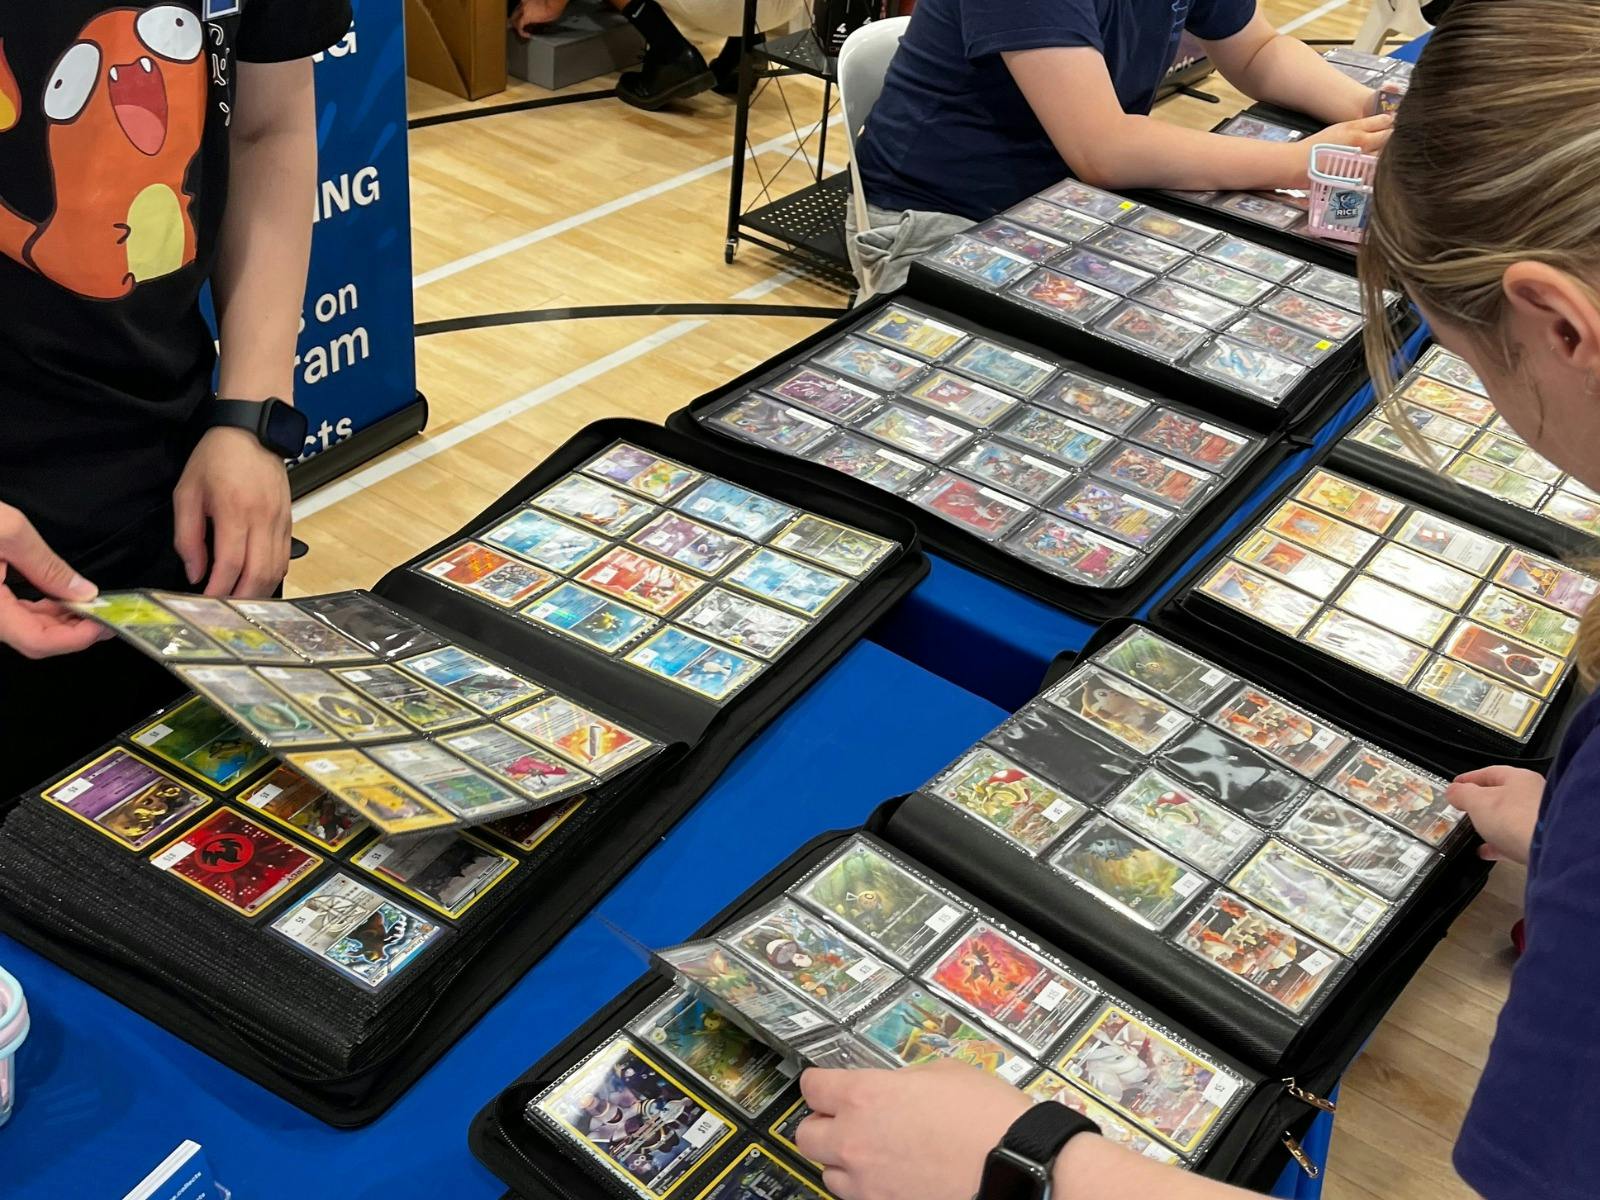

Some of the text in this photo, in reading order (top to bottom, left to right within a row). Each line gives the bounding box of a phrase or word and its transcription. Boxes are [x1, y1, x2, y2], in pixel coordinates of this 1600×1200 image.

[1336, 208, 1359, 217] RICE
[314, 283, 358, 323] on
[286, 417, 353, 465] cts
[697, 1121, 712, 1134] $10
